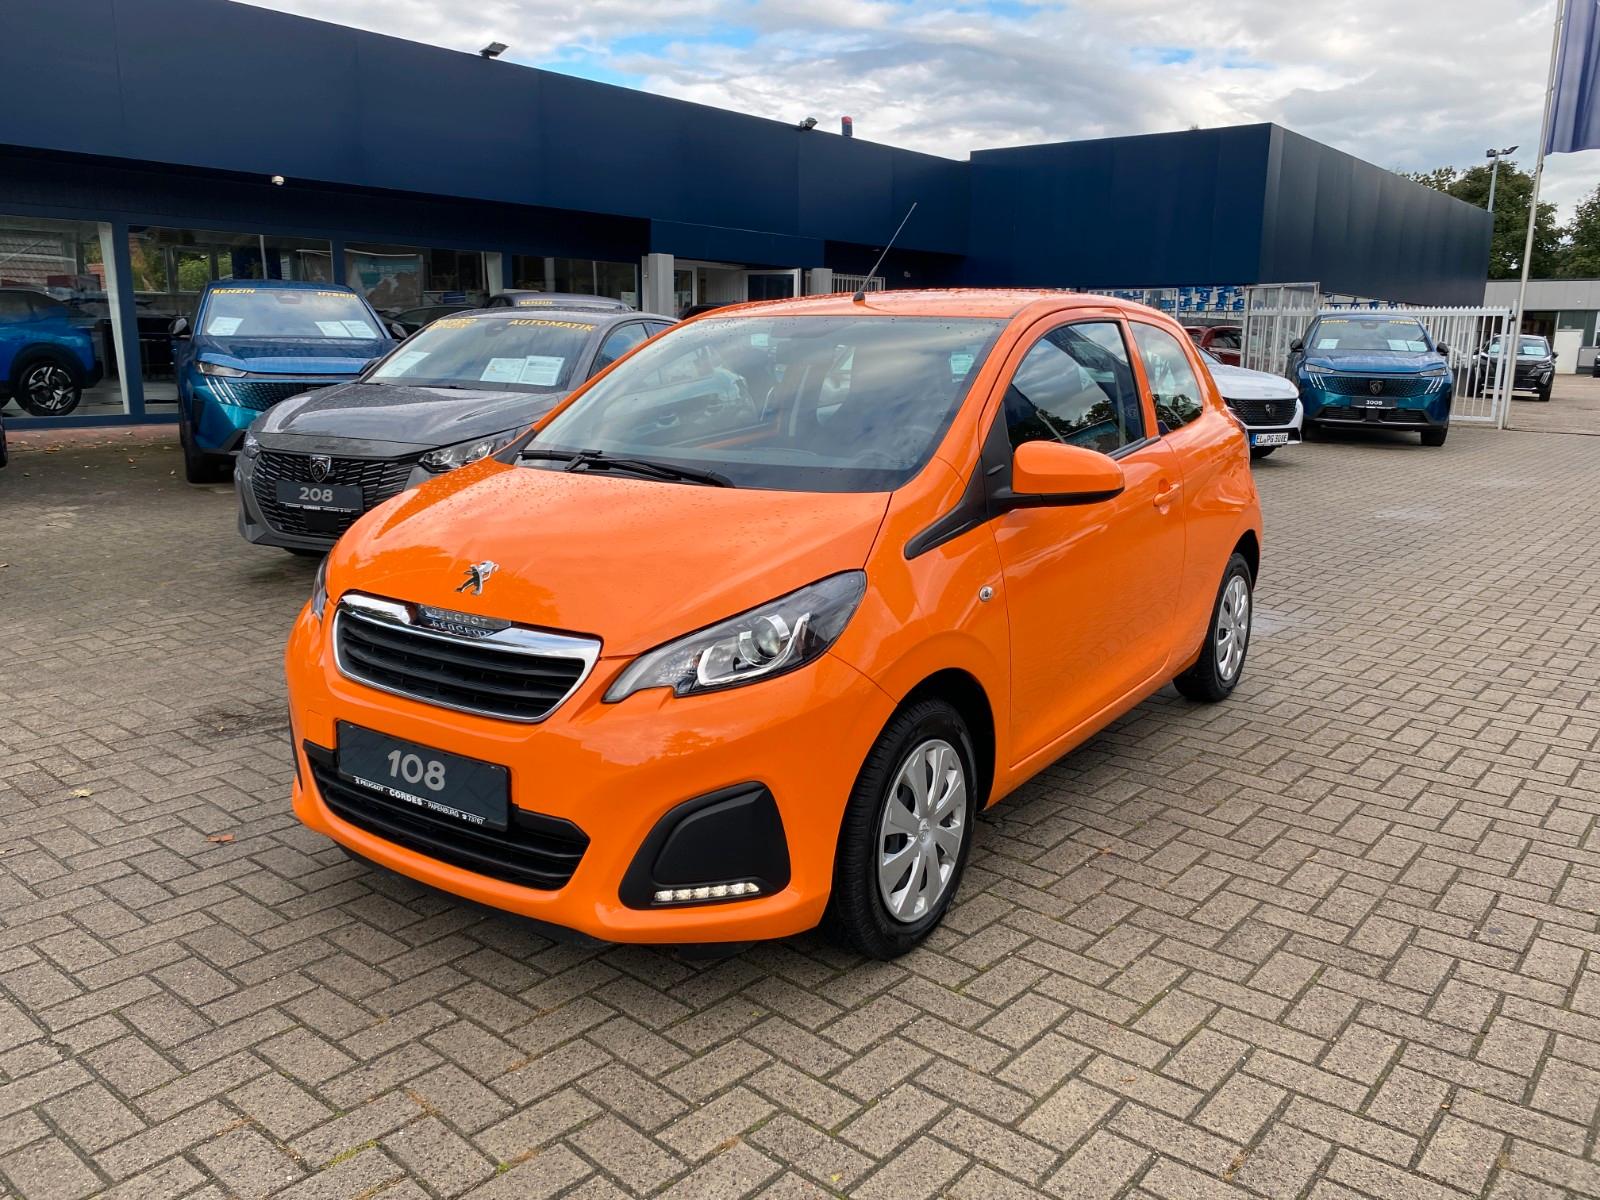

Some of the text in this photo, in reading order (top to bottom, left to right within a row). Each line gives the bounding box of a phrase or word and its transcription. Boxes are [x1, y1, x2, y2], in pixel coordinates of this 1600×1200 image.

[508, 318, 597, 332] AUTOMATIK
[299, 486, 334, 502] 208
[387, 749, 446, 791] 108
[388, 787, 423, 806] CORDES
[427, 800, 460, 818] PAPENBURG
